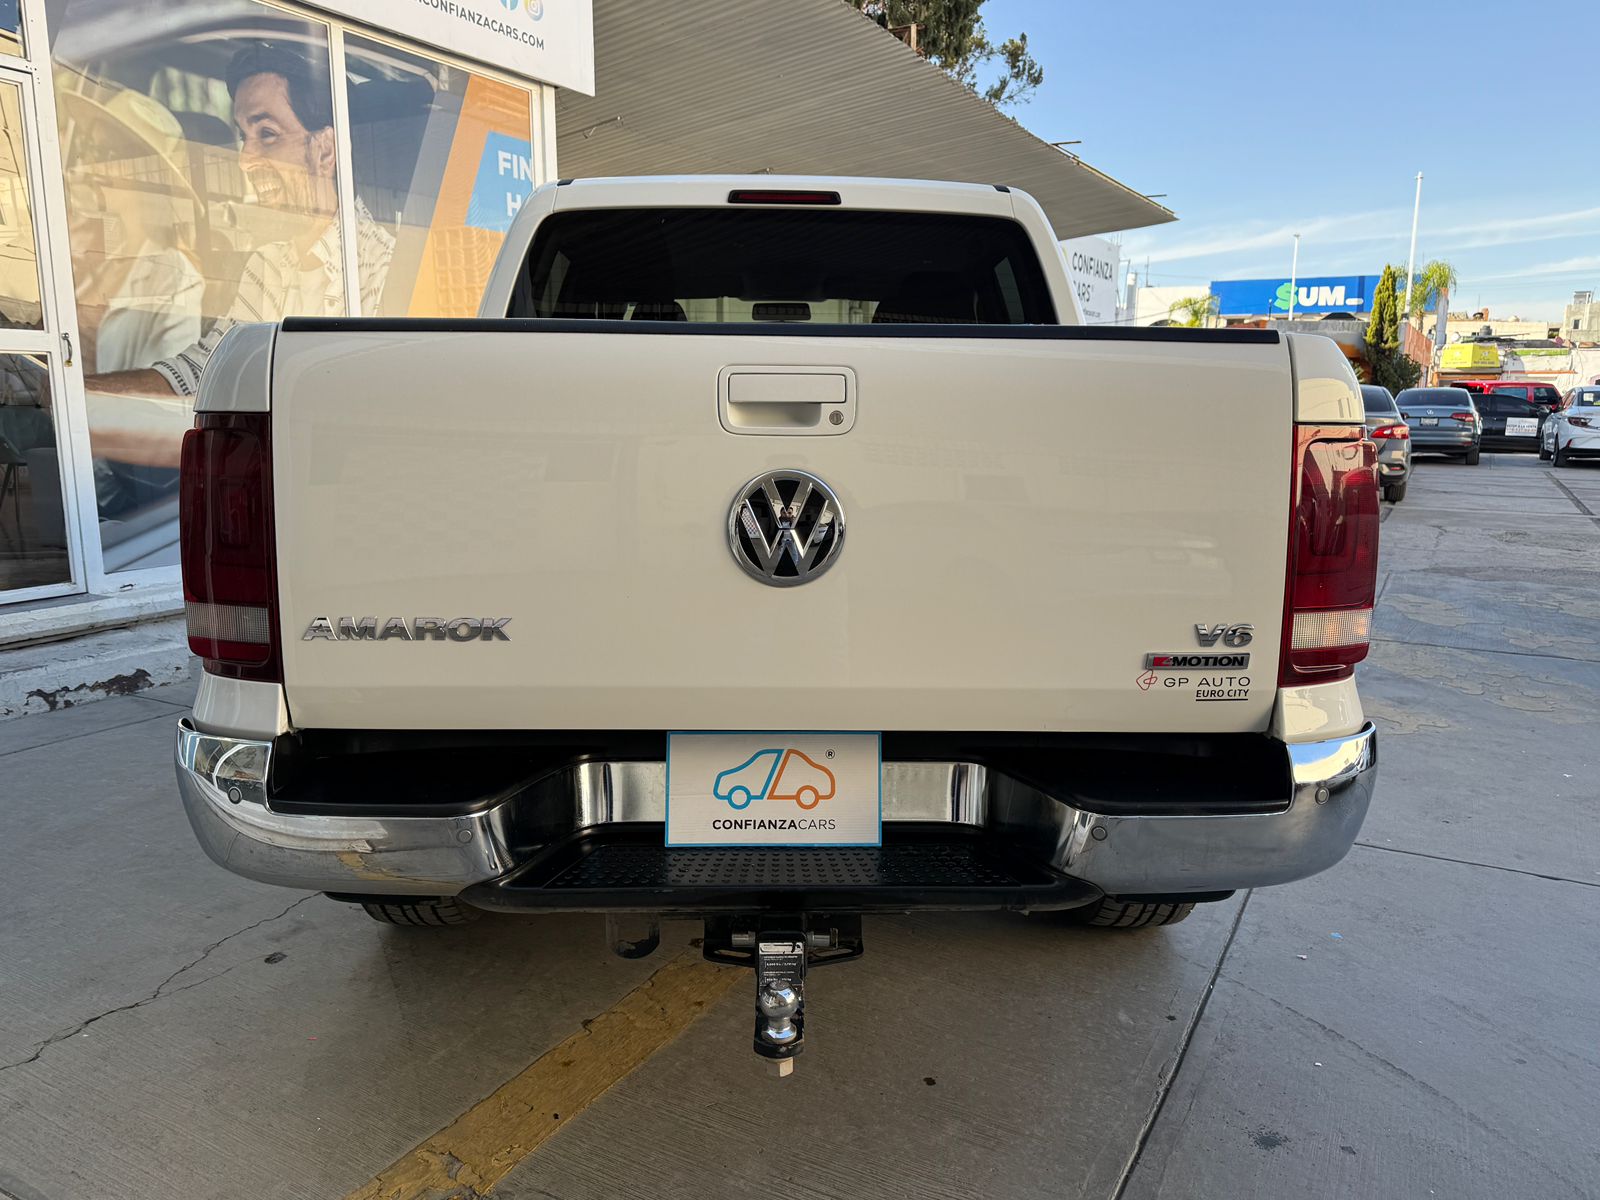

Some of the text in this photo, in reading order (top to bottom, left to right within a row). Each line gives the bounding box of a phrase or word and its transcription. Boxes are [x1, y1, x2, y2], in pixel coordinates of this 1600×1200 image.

[1072, 252, 1113, 282] CONFIANZA
[301, 616, 513, 642] AMAROK
[1195, 623, 1254, 648] V6
[1163, 676, 1251, 688] GP AUTO
[1195, 688, 1250, 698] EURO CITY
[712, 819, 836, 830] CONFIANZACARS
